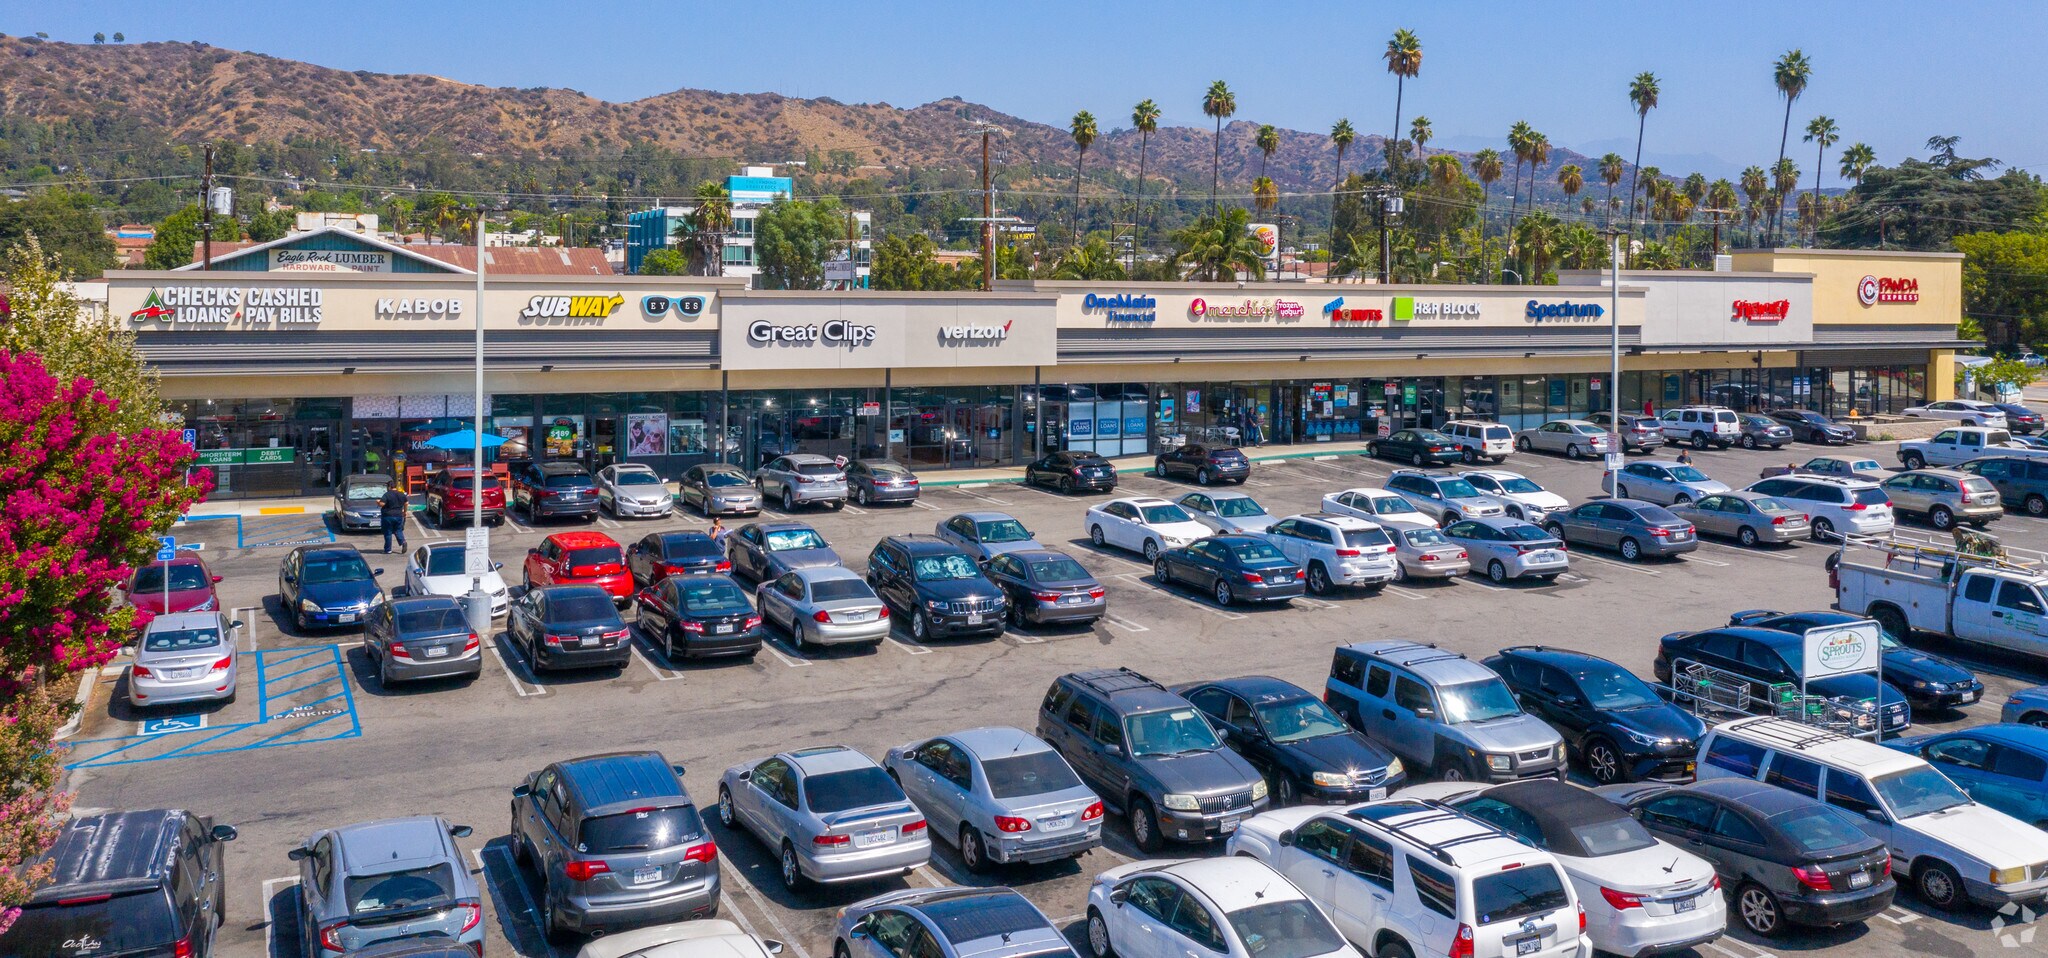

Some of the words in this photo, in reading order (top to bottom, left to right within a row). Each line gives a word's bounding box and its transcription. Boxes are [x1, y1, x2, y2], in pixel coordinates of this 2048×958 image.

[277, 251, 305, 263] Eagle
[305, 251, 332, 263] Rock
[335, 253, 385, 264] LUMBER
[282, 263, 336, 271] HARDWARE
[1879, 277, 1918, 293] PANDA
[163, 287, 241, 306] CHECKS
[247, 288, 322, 307] CASHED
[1085, 293, 1156, 309] OneMain
[1276, 299, 1299, 310] frozen
[378, 298, 464, 314] KABOB
[522, 293, 625, 319] SUBWAY
[1280, 306, 1304, 317] yogurt
[1413, 303, 1439, 315] H&R
[1443, 303, 1481, 315] BLOCK
[1526, 300, 1602, 321] Spectrum
[177, 307, 231, 322] LOANS
[245, 307, 275, 322] PAY
[280, 307, 322, 322] BILLS
[1108, 311, 1156, 322] Financial
[1332, 309, 1383, 321] DONUTS
[749, 320, 817, 342] Great
[822, 320, 876, 346] Clips
[942, 322, 1006, 339] verizon
[1822, 642, 1862, 661] SPROUTS
[272, 708, 343, 720] PARKING
